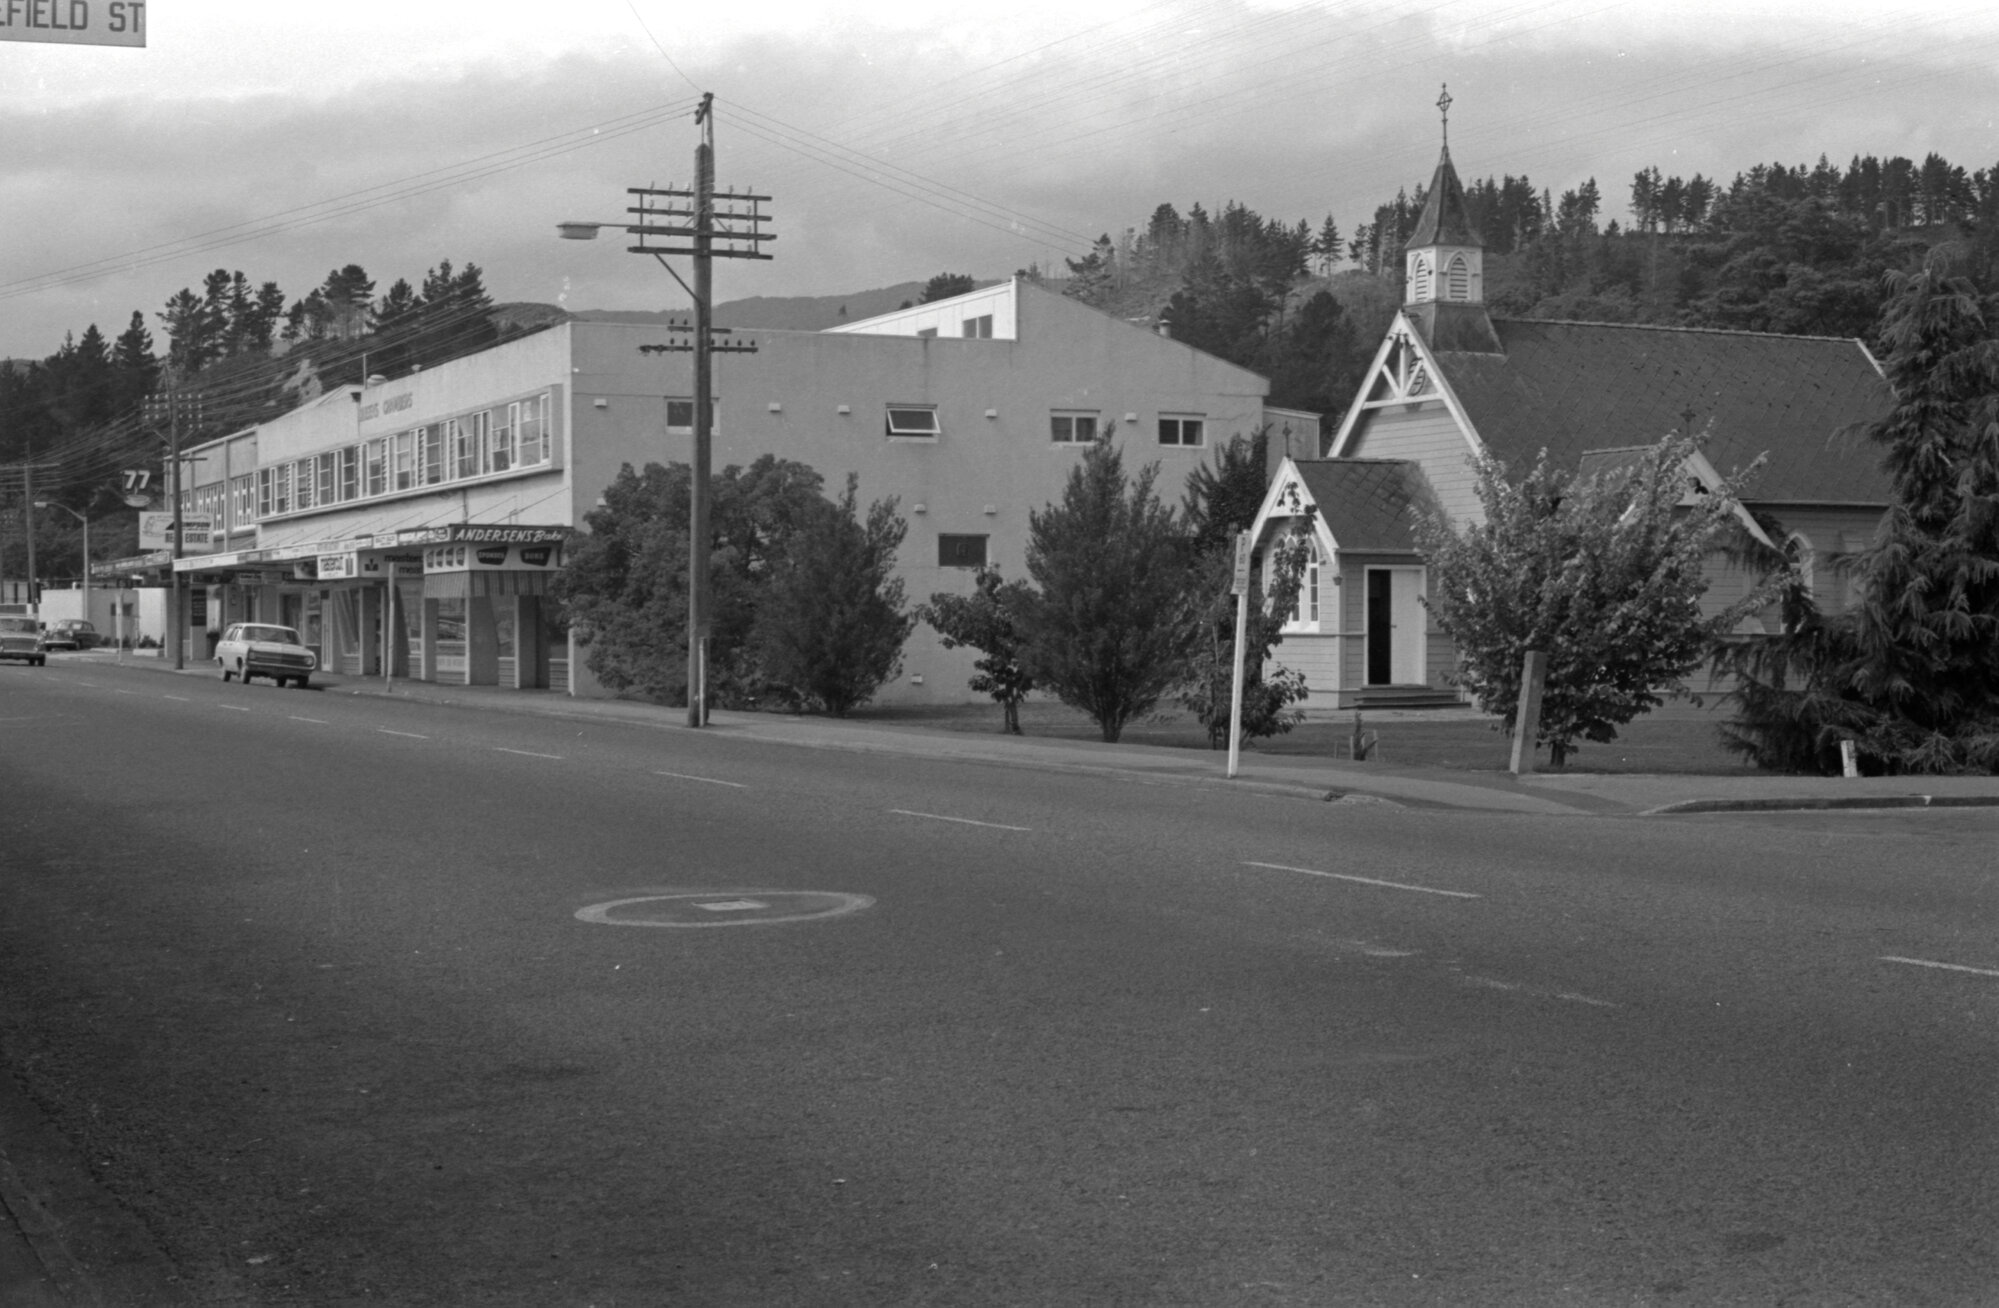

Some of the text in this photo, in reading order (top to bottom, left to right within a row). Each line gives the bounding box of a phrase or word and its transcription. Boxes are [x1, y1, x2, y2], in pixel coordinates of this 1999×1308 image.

[109, 2, 144, 33] ST
[124, 470, 151, 489] 77
[185, 533, 208, 544] ESTATE
